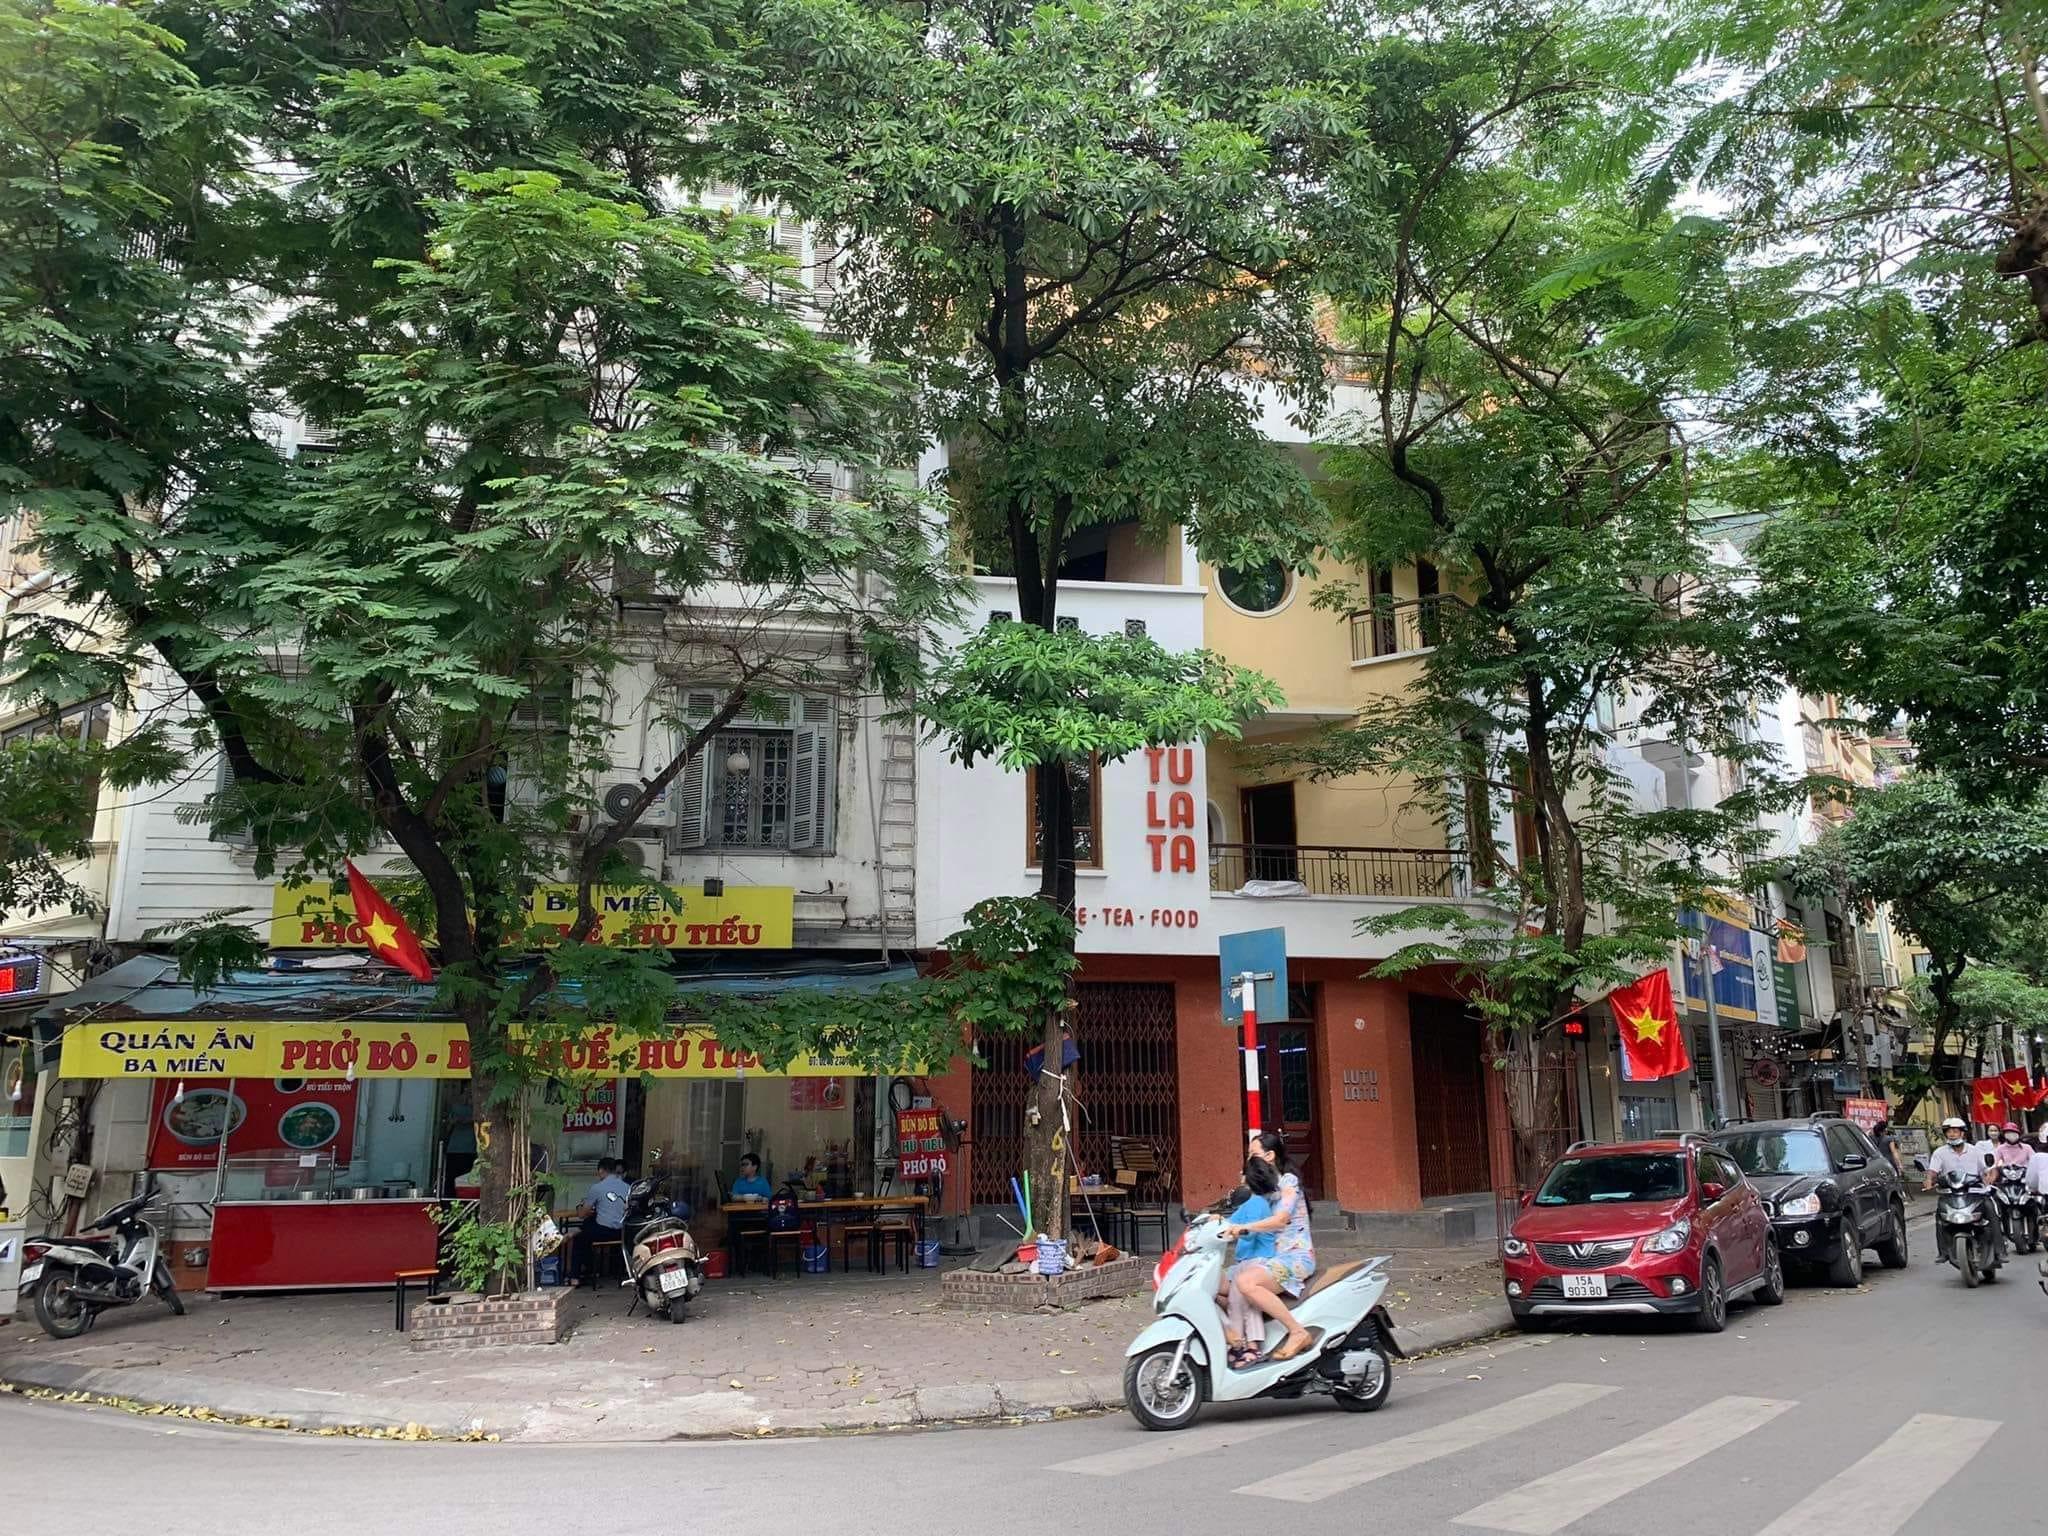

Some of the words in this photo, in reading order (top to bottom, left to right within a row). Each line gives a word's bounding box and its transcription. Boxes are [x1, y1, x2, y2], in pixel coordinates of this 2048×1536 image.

[1144, 747, 1193, 785] TU
[1147, 791, 1195, 829] LA
[1146, 834, 1197, 873] TA
[685, 915, 762, 944] TIẾU
[1103, 908, 1134, 926] TEA
[1151, 909, 1199, 928] FOOD
[100, 1027, 196, 1053] QUÁN
[208, 1027, 255, 1050] ĂN
[281, 1028, 361, 1070] PHỞ
[367, 1031, 418, 1070] BÒ
[638, 1027, 692, 1070] HỦ
[124, 1059, 157, 1072] BA
[1344, 1069, 1377, 1085] LUTU
[1344, 1086, 1379, 1101] LATA
[1568, 1286, 1602, 1297] 903.80
[1575, 1275, 1593, 1286] 15A
